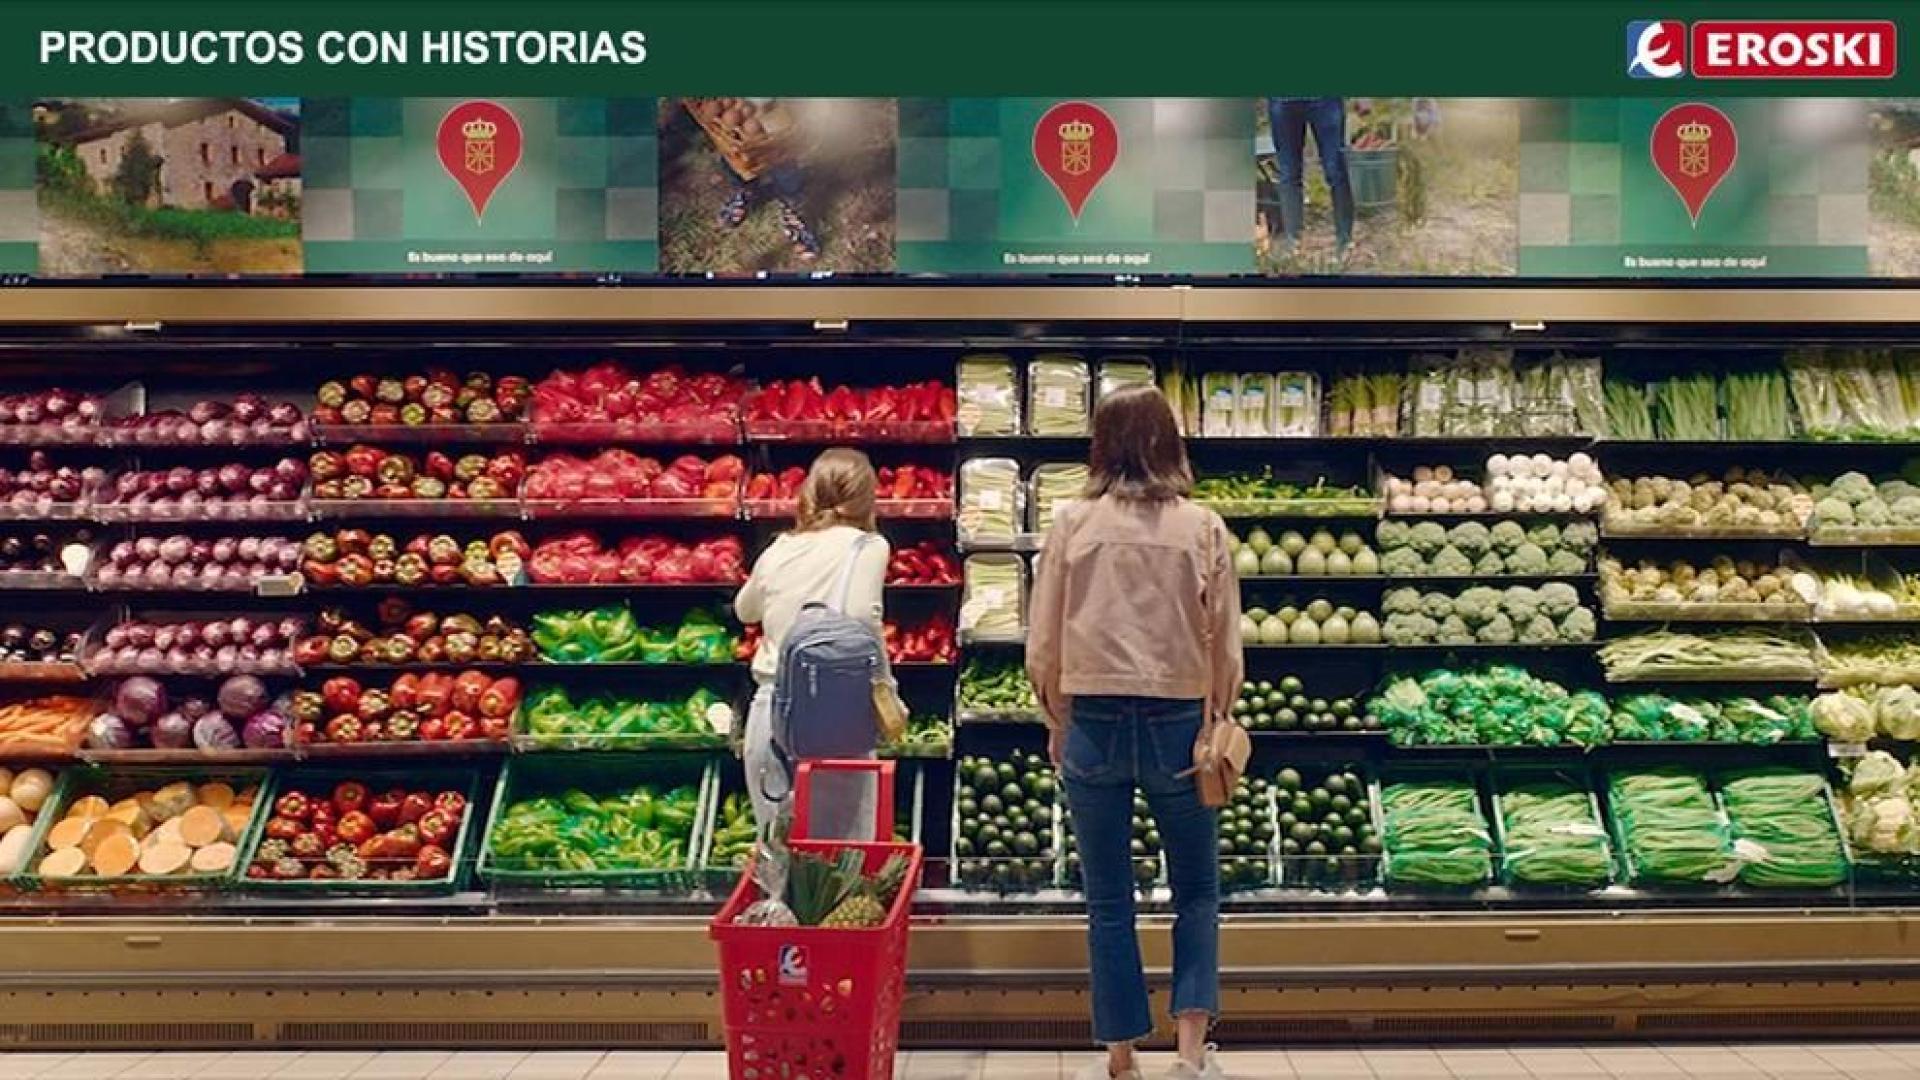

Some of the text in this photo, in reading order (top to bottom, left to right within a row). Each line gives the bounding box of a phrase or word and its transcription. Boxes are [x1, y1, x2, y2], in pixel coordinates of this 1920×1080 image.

[422, 251, 458, 262] bueno
[461, 253, 482, 264] que
[508, 251, 523, 262] de
[1018, 253, 1055, 264] bueno
[1057, 255, 1080, 266] que
[1106, 253, 1120, 264] de
[1638, 256, 1674, 267] bueno
[1676, 257, 1698, 269] que
[1723, 256, 1738, 267] de
